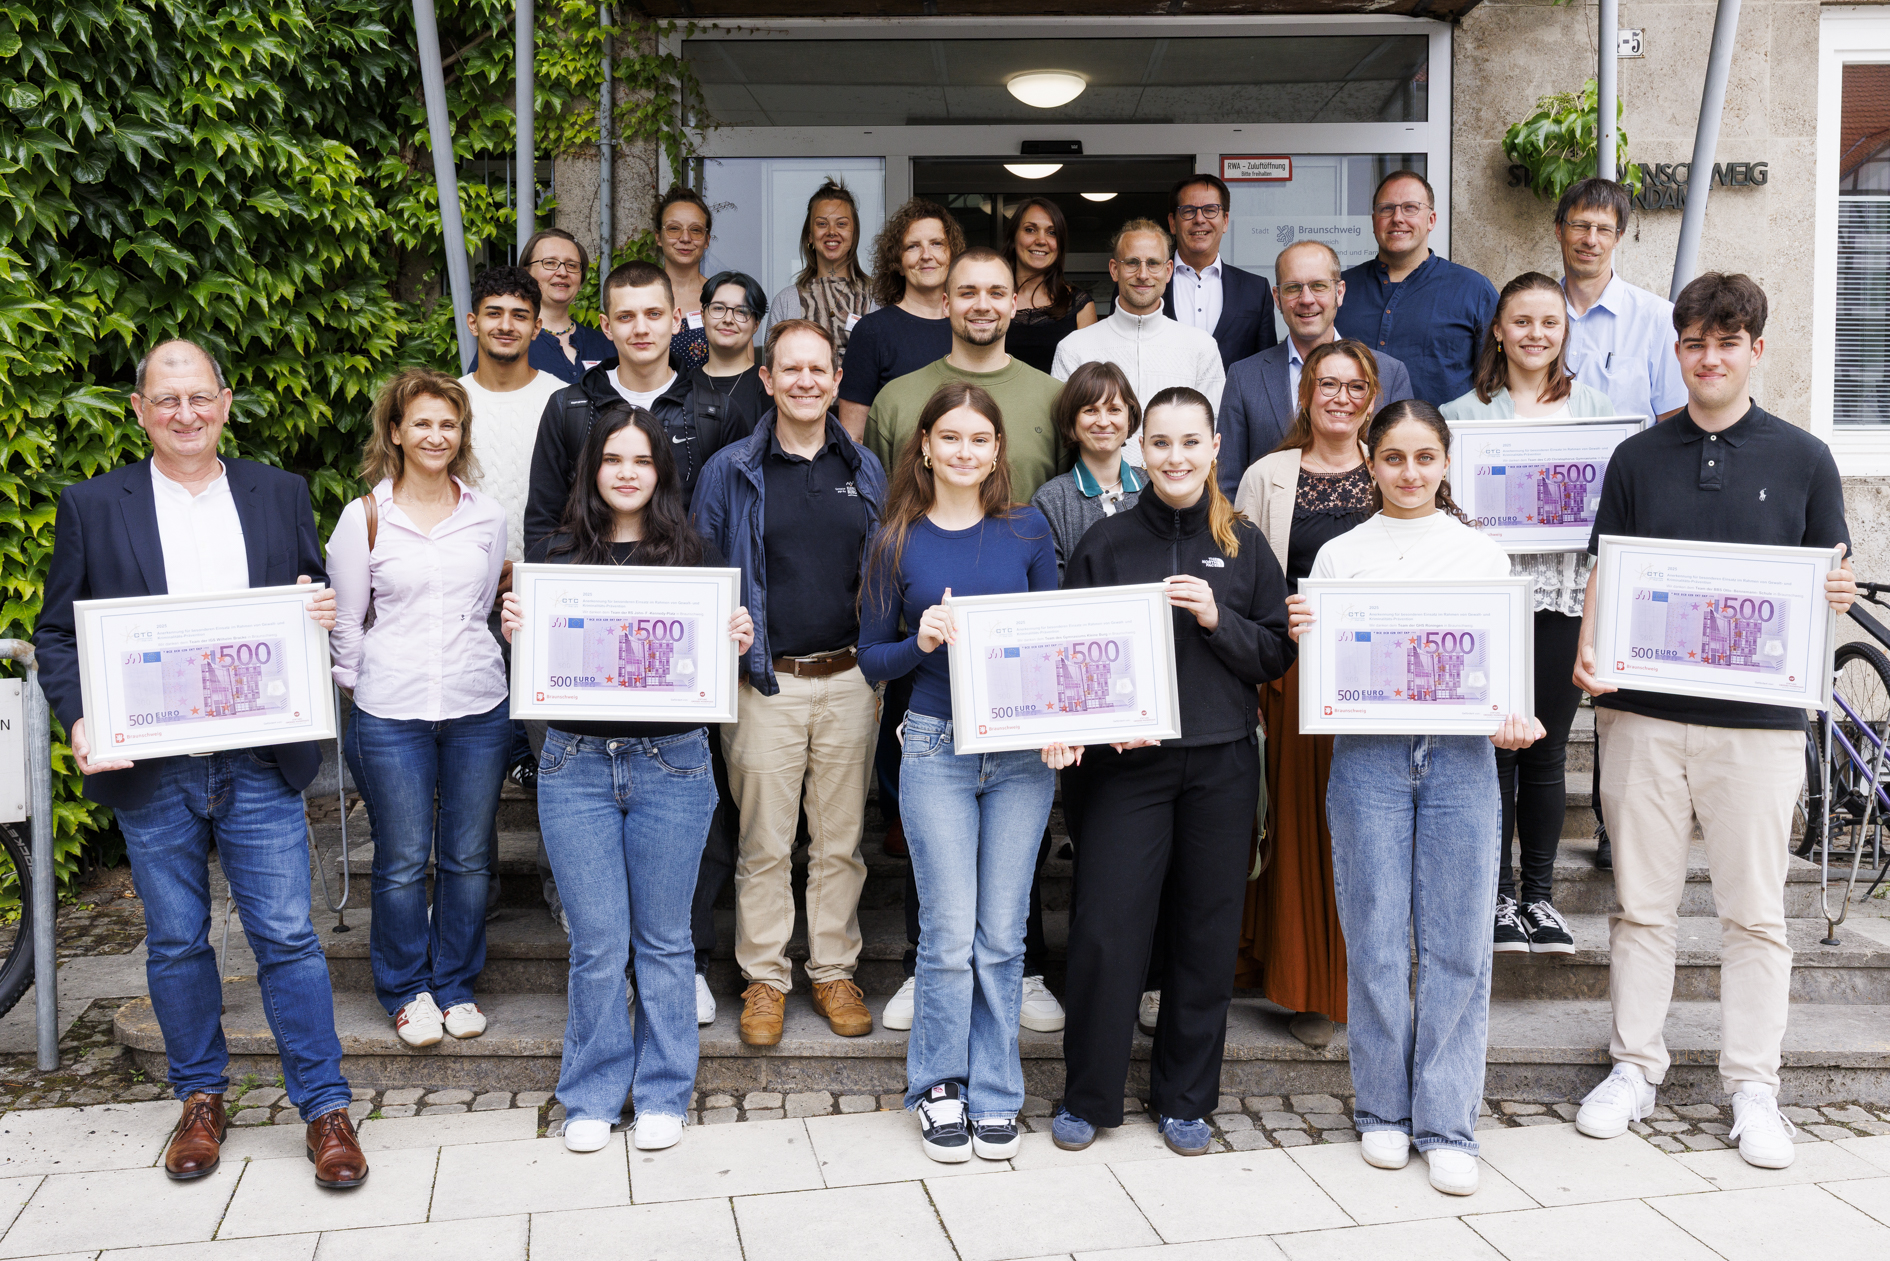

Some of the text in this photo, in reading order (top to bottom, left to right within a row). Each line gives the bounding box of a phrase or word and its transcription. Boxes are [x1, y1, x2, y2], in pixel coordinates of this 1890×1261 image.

[1247, 162, 1286, 171] Zuluftöffnung
[1298, 225, 1361, 236] Braunschweig
[1554, 464, 1596, 484] 500
[1476, 516, 1496, 526] 500
[1723, 597, 1775, 624] 500
[637, 620, 684, 643] 500
[1426, 632, 1475, 655] 500
[219, 642, 272, 669] 500
[1072, 640, 1120, 666] 500
[1631, 647, 1654, 659] 500
[1628, 664, 1659, 673] Braunschweig
[550, 676, 572, 687] 500
[1338, 690, 1360, 701] 500
[991, 706, 1013, 719] 500
[128, 713, 154, 726] 500
[127, 731, 162, 740] Braunschweig
